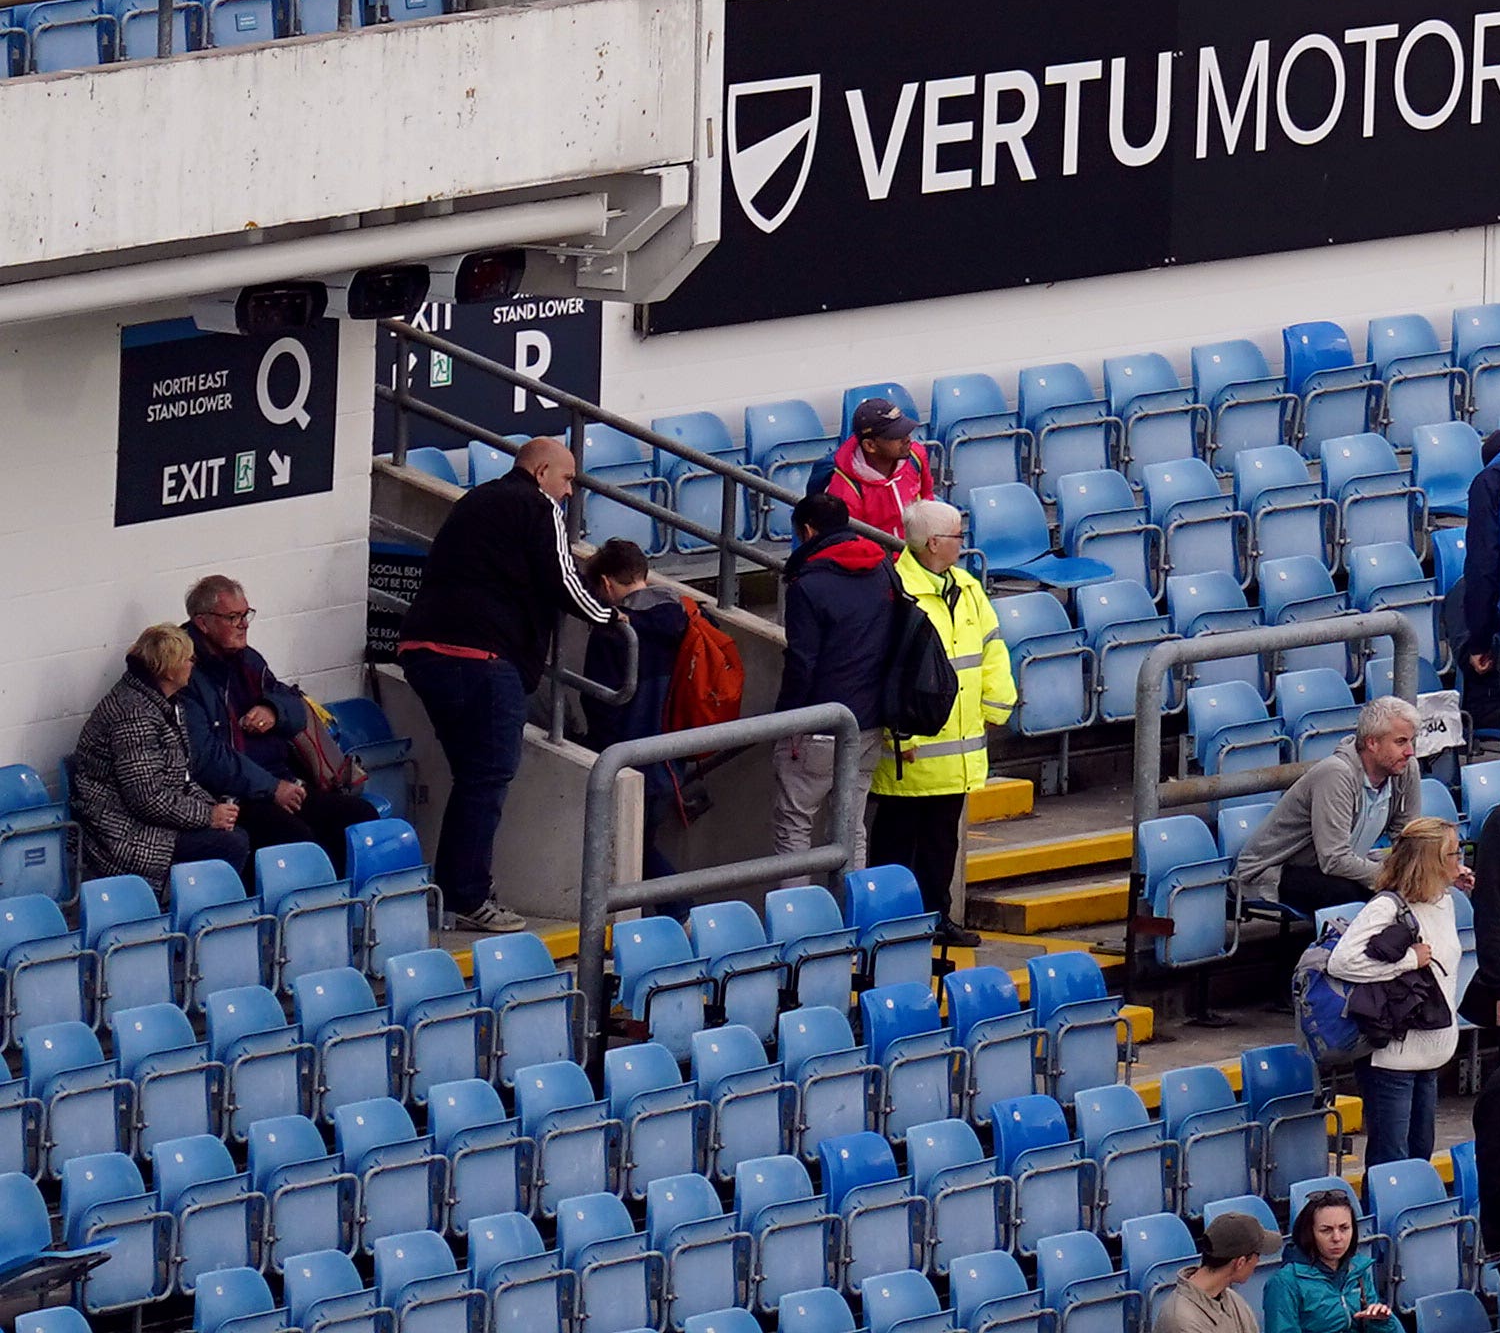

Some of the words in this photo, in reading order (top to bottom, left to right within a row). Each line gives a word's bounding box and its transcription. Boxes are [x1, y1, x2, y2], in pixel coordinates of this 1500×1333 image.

[845, 52, 1172, 200] VERTU
[493, 302, 536, 324] STAND
[539, 298, 584, 317] LOWER
[153, 376, 193, 398] NORTH
[195, 370, 231, 391] EAST
[257, 338, 311, 430] Q
[512, 329, 560, 414] R
[147, 401, 187, 422] STAND
[190, 393, 232, 415] LOWER
[162, 457, 225, 504] EXIT
